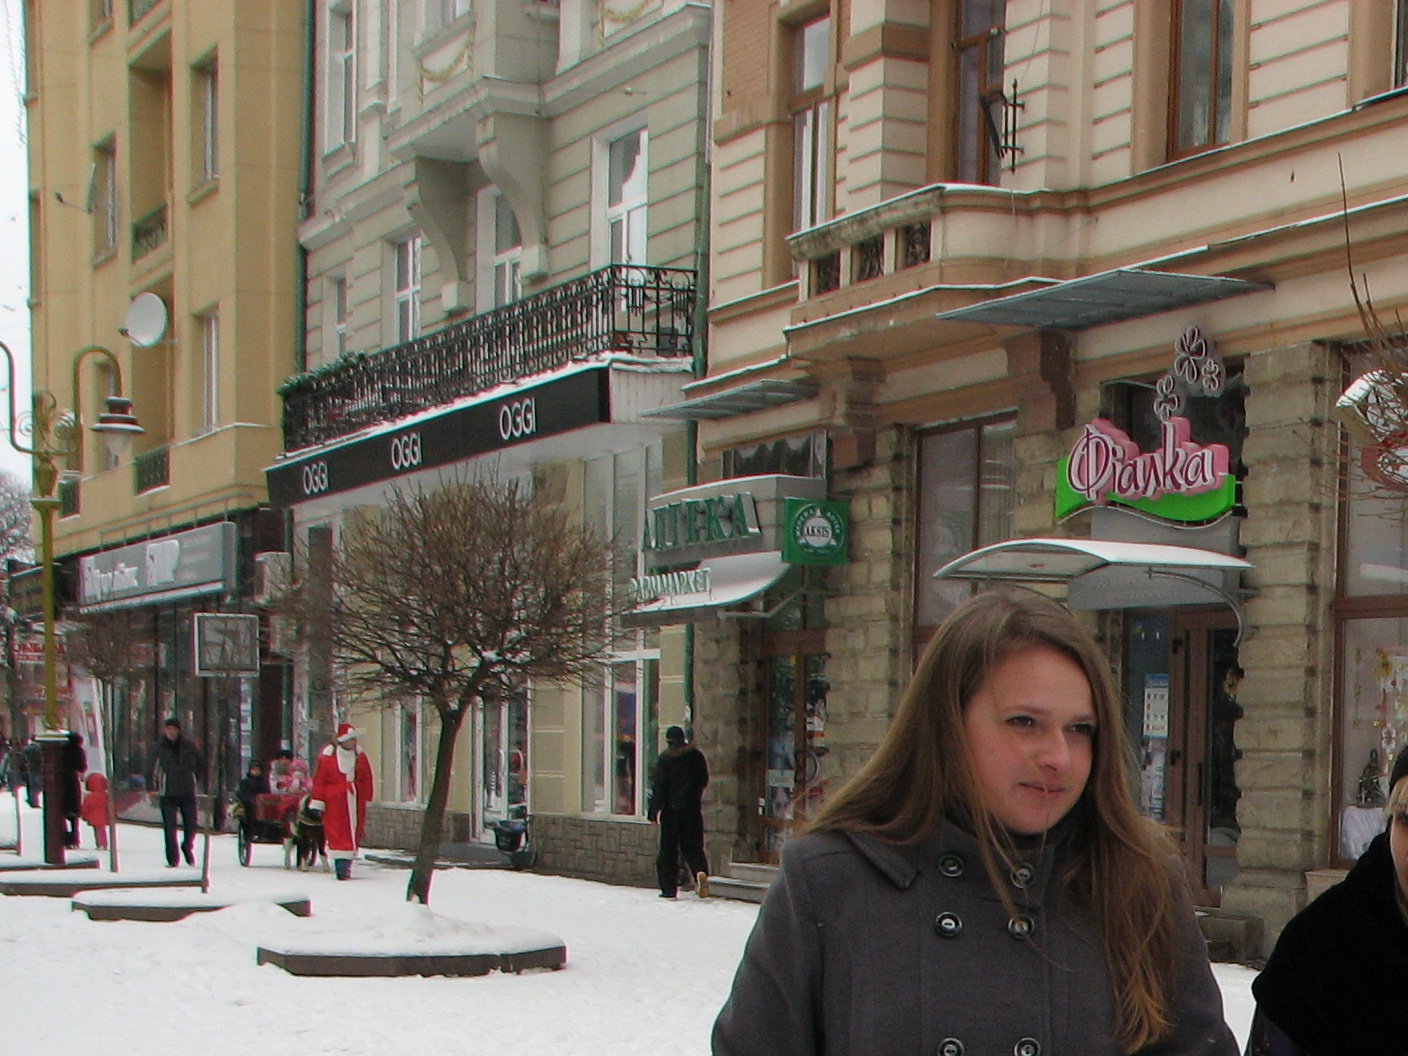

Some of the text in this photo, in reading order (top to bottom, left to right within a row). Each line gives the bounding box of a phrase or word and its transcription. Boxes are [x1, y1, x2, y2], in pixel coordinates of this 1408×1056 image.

[499, 397, 536, 441] OGGI
[391, 432, 423, 470] OGGI
[1067, 423, 1216, 501] Фіалка
[303, 461, 328, 494] OGGI
[642, 491, 761, 551] АПТЕКА
